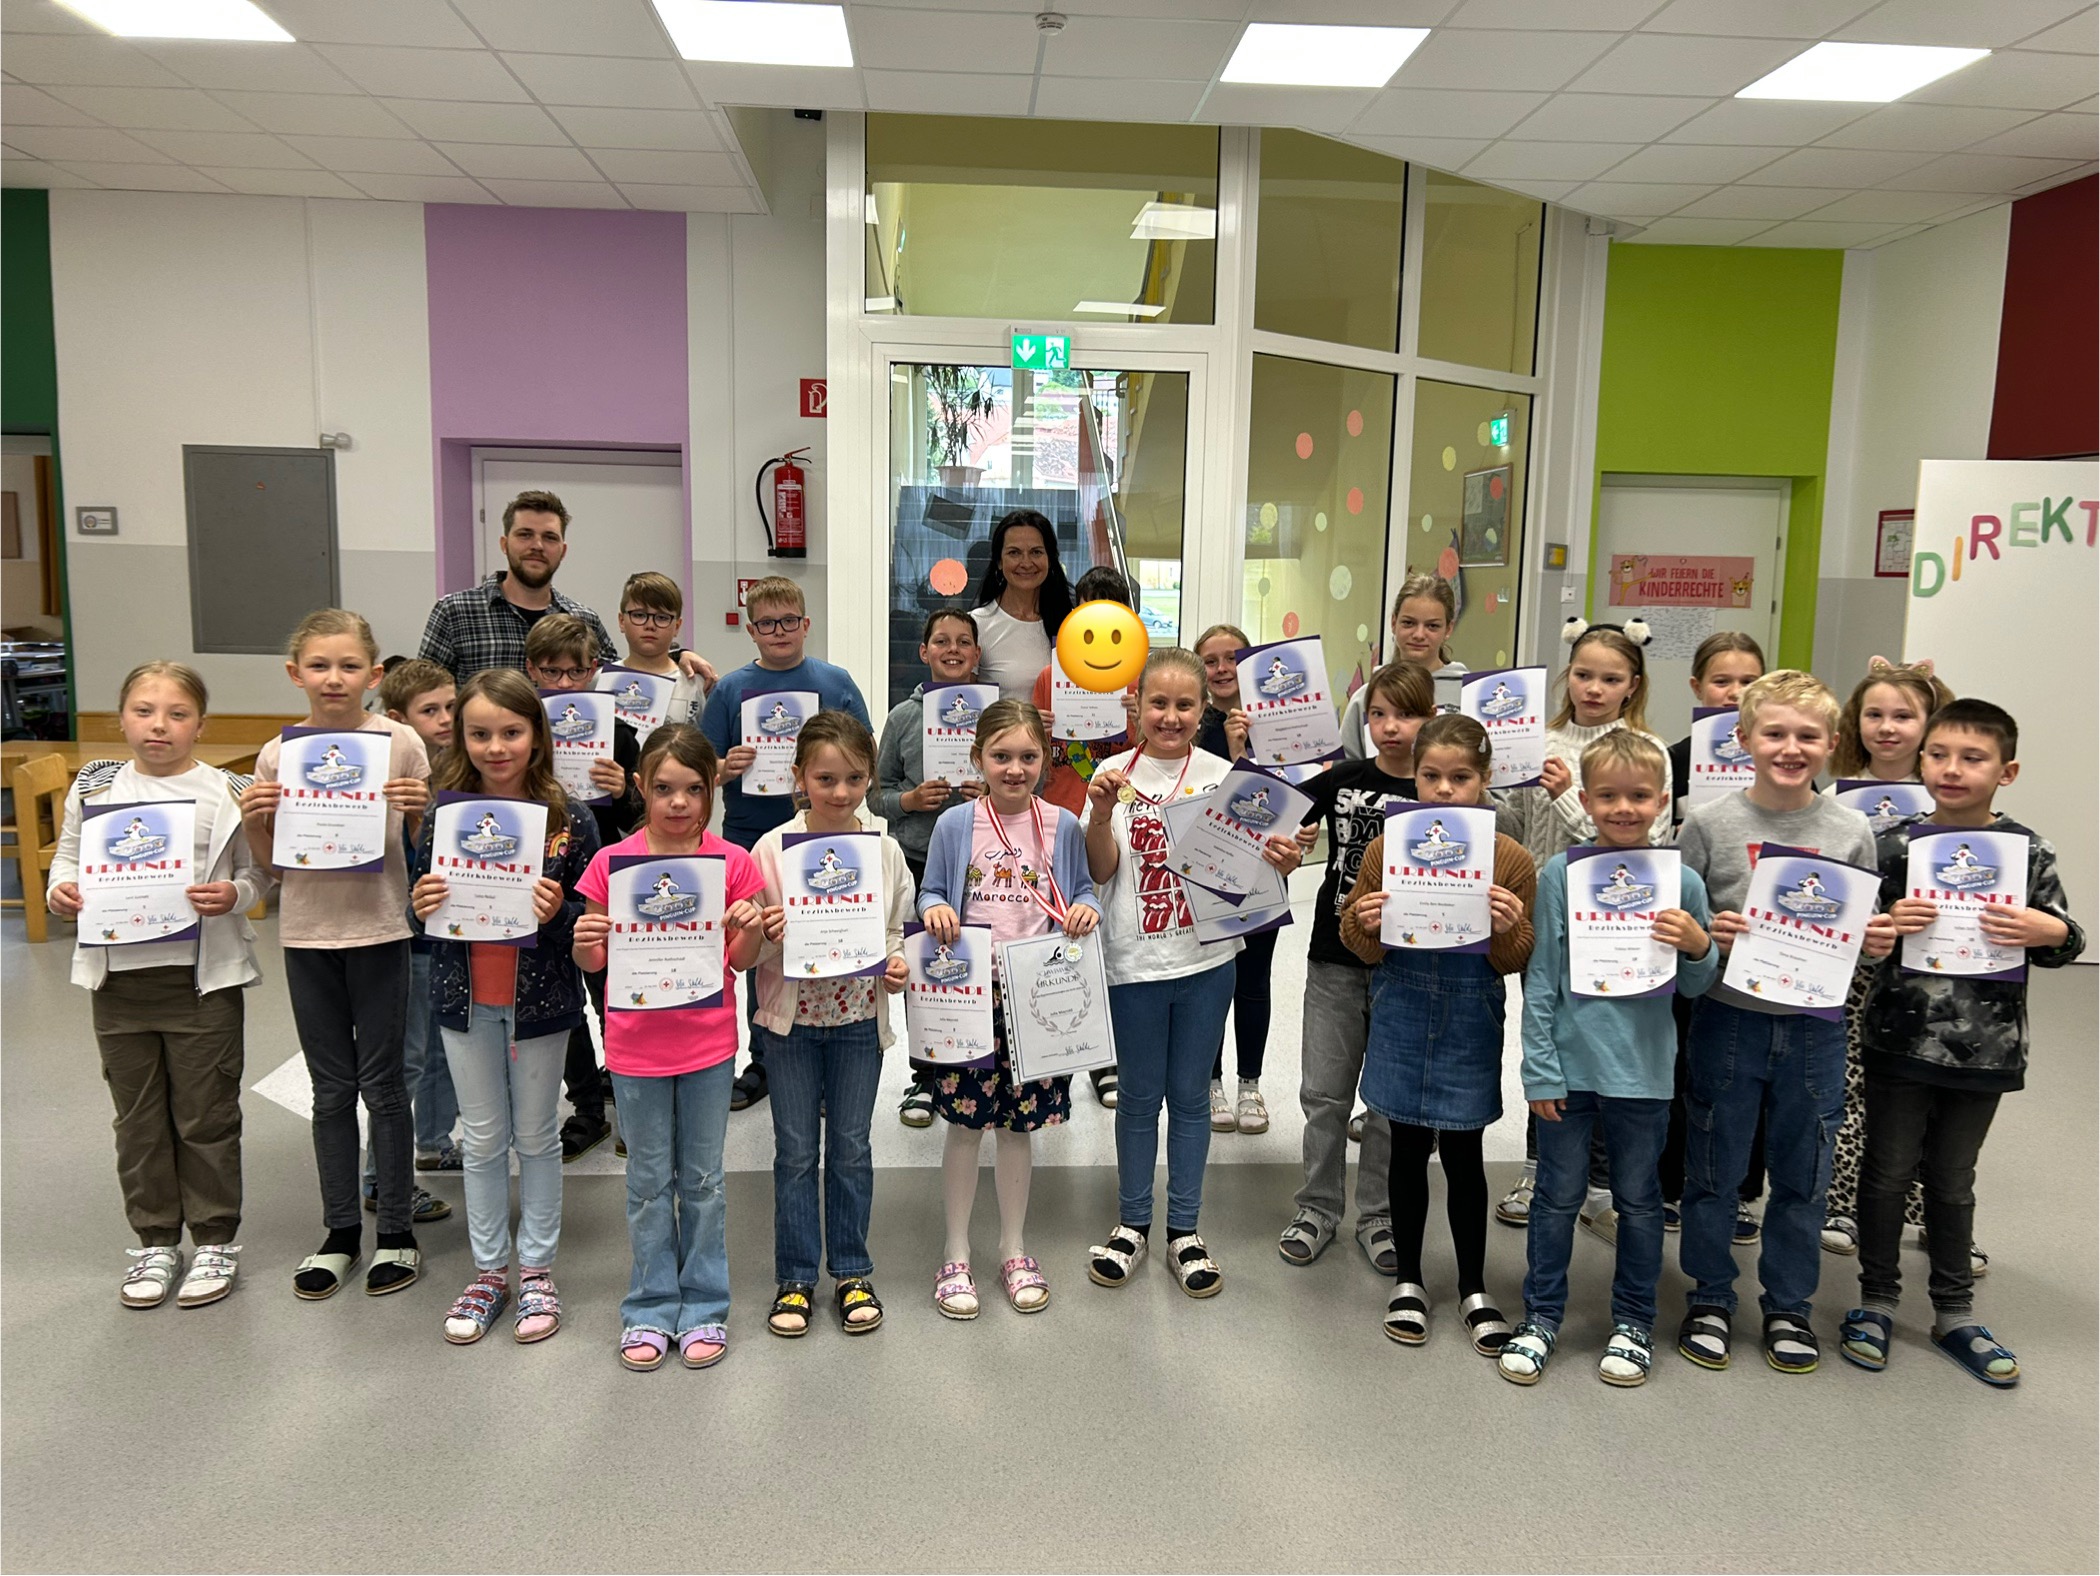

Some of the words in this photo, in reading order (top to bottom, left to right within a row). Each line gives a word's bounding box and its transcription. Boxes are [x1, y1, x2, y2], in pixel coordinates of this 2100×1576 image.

[1912, 496, 2099, 598] DIREKT
[1650, 567, 1667, 578] WIR
[1671, 568, 1698, 579] FEIERN
[1702, 568, 1714, 579] DIE
[1639, 581, 1724, 598] KINDERRECHTE
[1246, 692, 1325, 713] URKUNDE
[615, 708, 660, 724] KUNDE
[1486, 716, 1540, 728] KUNDE
[553, 741, 609, 749] KUNDE
[746, 735, 796, 743] URKUN
[1695, 764, 1757, 773] URKUN
[283, 788, 382, 801] URKUNDE
[295, 801, 368, 810] Bezirksbewerb
[86, 859, 188, 875] URKUNDE
[437, 856, 537, 875] URKUNDE
[98, 874, 175, 882] Bezirksbewerb
[449, 871, 523, 882] Bezirksbewerb
[1389, 865, 1487, 880] URKUNDE
[1401, 880, 1474, 888] Bezirksbewerb
[789, 893, 878, 907] URKUNDE
[972, 891, 1029, 903] Morocco
[1913, 888, 2019, 905] URKUNDE
[659, 907, 697, 921] PINGUIN-CUP
[801, 906, 867, 915] Bezirksbewerb
[615, 920, 719, 933] URKUNDE
[1175, 927, 1194, 937] GREATE
[1749, 906, 1857, 945] URKUNDE
[629, 935, 705, 943] Bezirksbewerb
[1759, 923, 1838, 950] Bezirksbewerb
[910, 982, 988, 996] URKUNDE
[920, 996, 977, 1004] Bezirksbewerb
